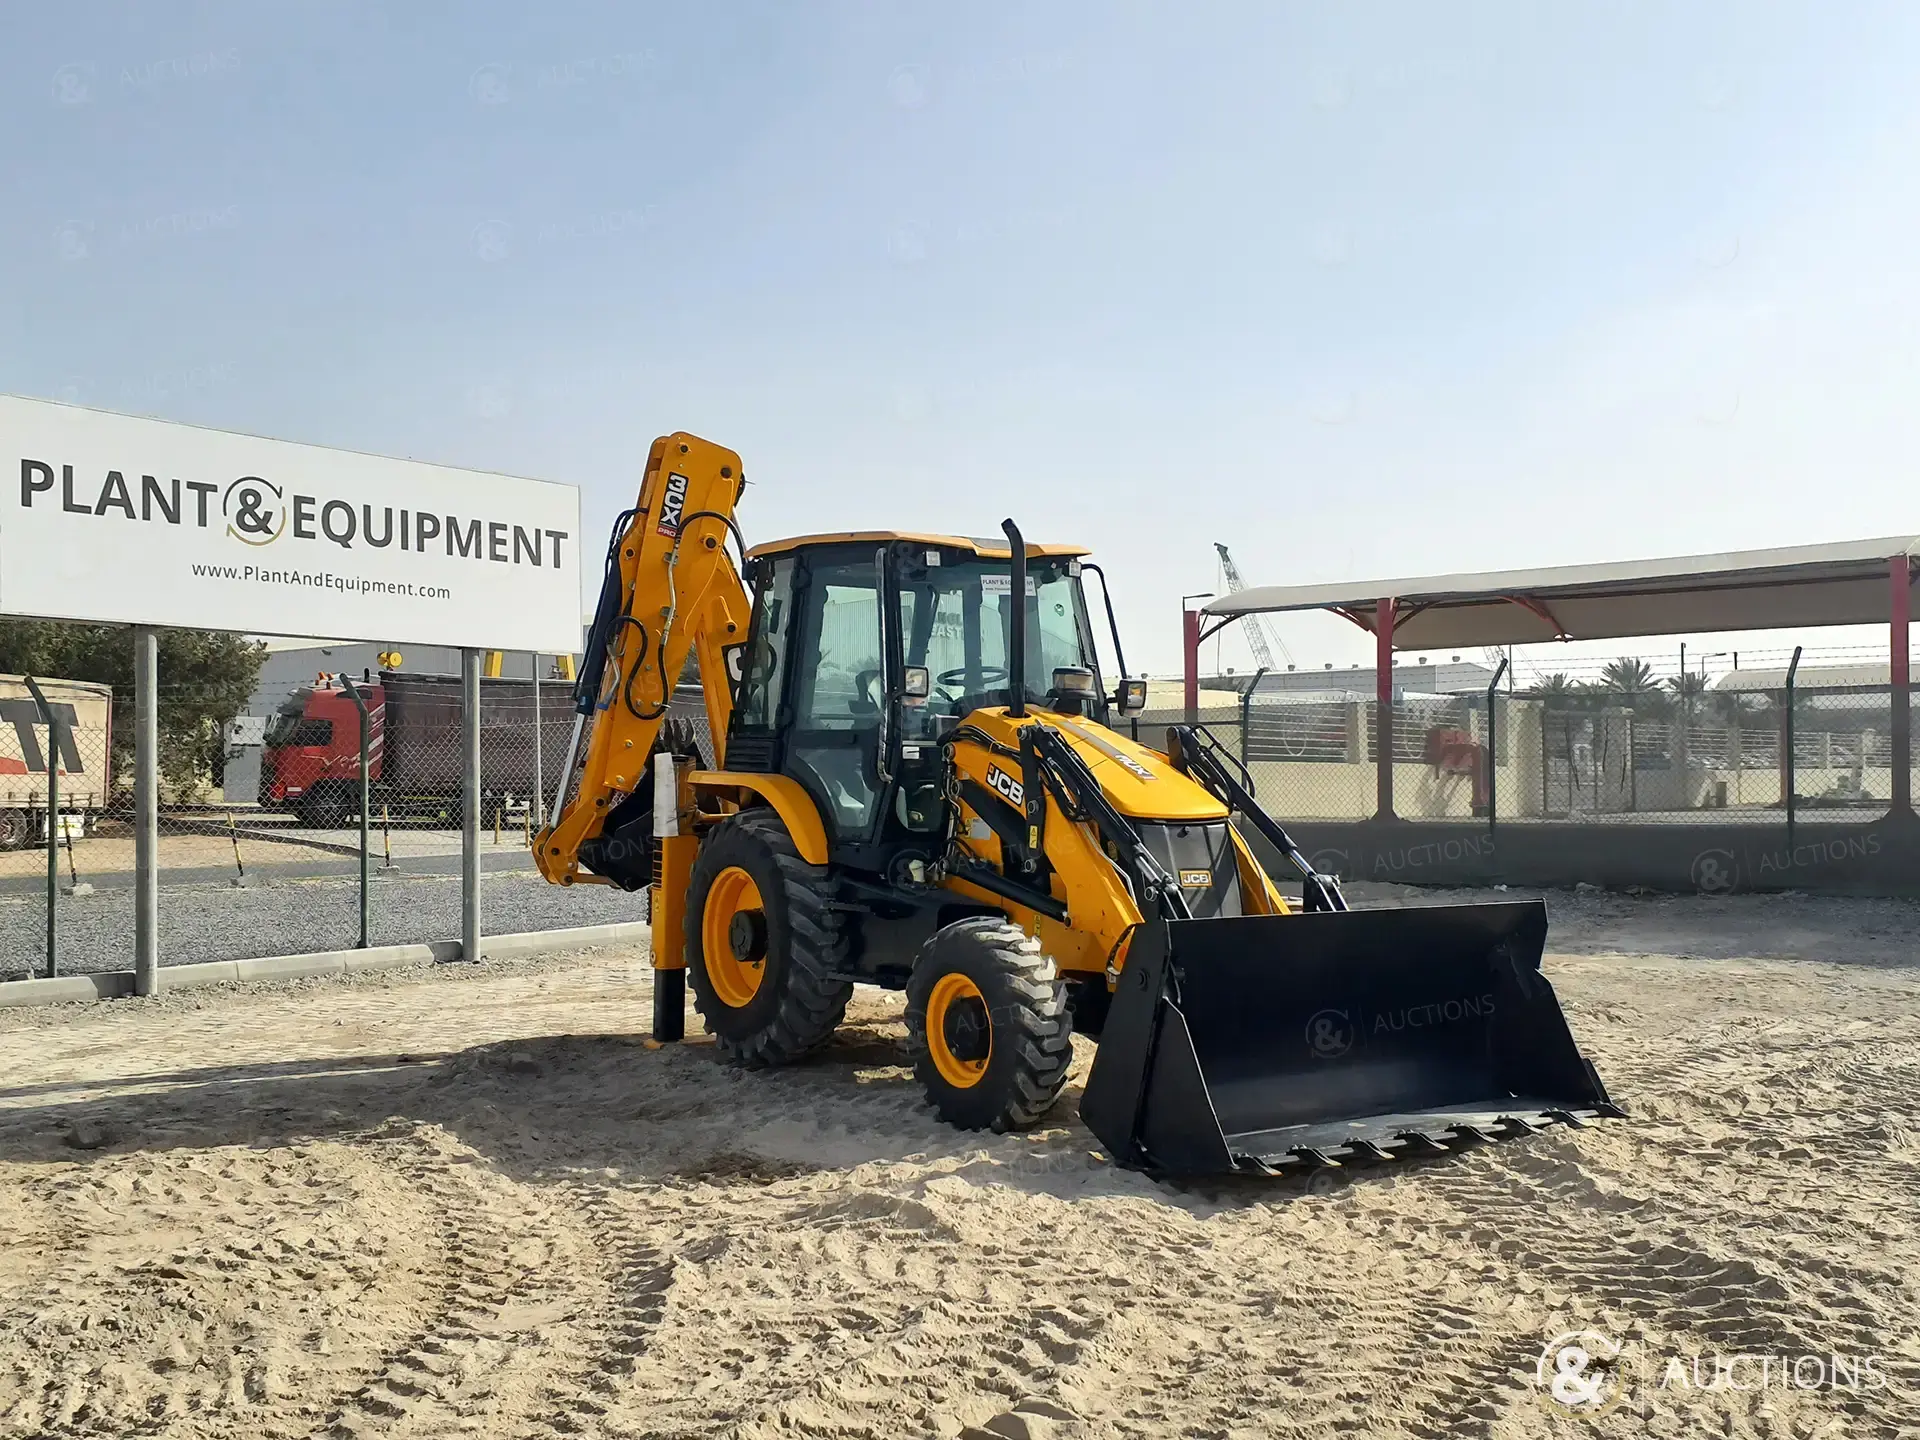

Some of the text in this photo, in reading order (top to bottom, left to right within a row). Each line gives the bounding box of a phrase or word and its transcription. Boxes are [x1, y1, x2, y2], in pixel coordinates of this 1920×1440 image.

[20, 458, 218, 527] PLANT
[293, 494, 569, 569] EQUIPMENT
[660, 474, 687, 526] 3CX
[658, 527, 676, 537] PRO
[192, 563, 450, 600] www.PlantAndEquipment.com
[987, 764, 1023, 805] JCB
[1183, 873, 1209, 884] JCB
